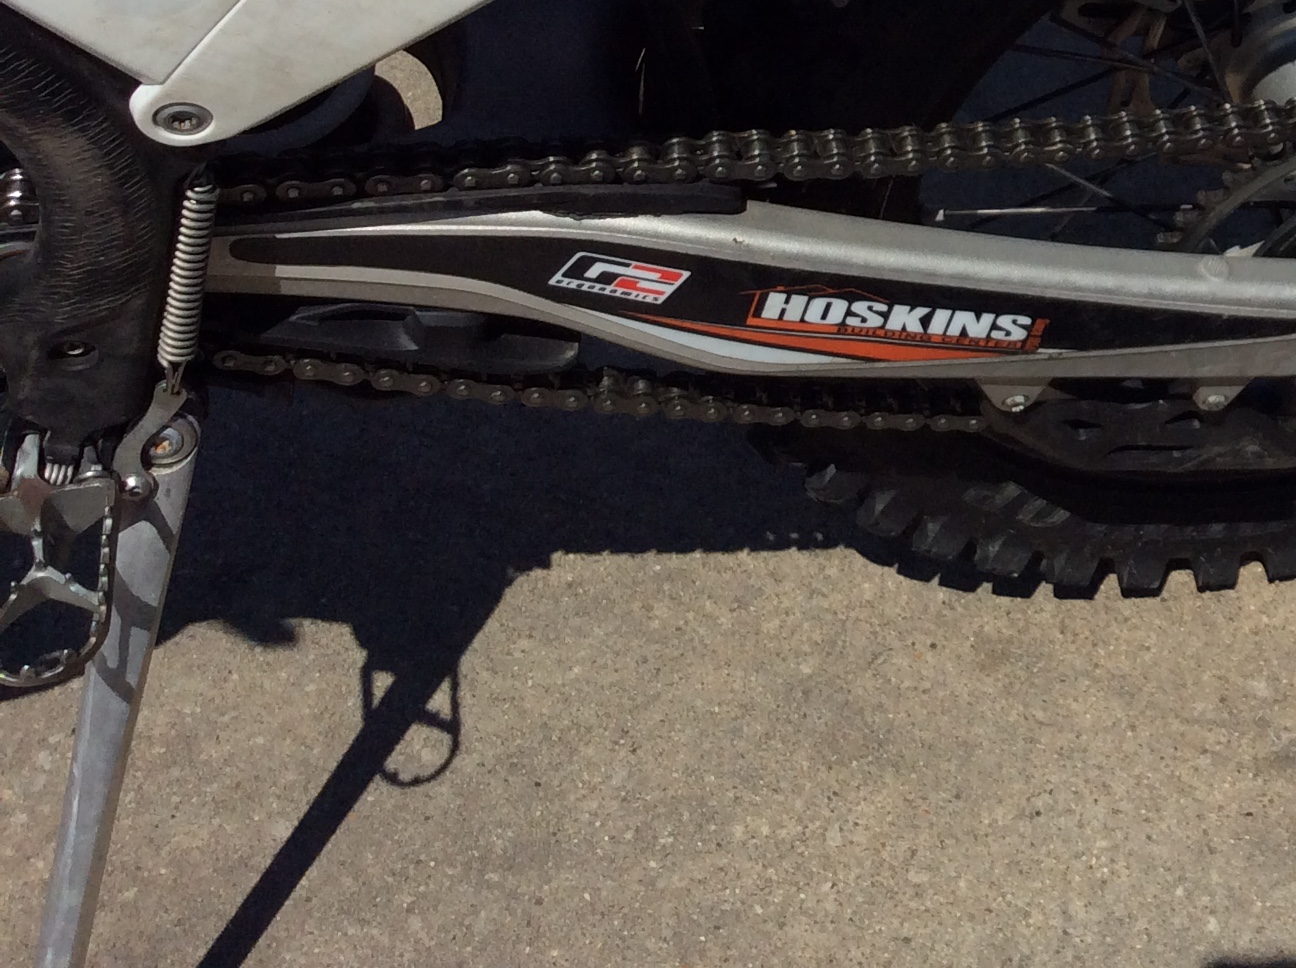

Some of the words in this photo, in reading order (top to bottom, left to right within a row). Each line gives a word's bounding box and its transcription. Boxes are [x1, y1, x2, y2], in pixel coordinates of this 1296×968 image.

[760, 291, 1033, 342] HOSKINS
[836, 325, 932, 342] BUILDING
[942, 334, 1023, 349] CENTER
